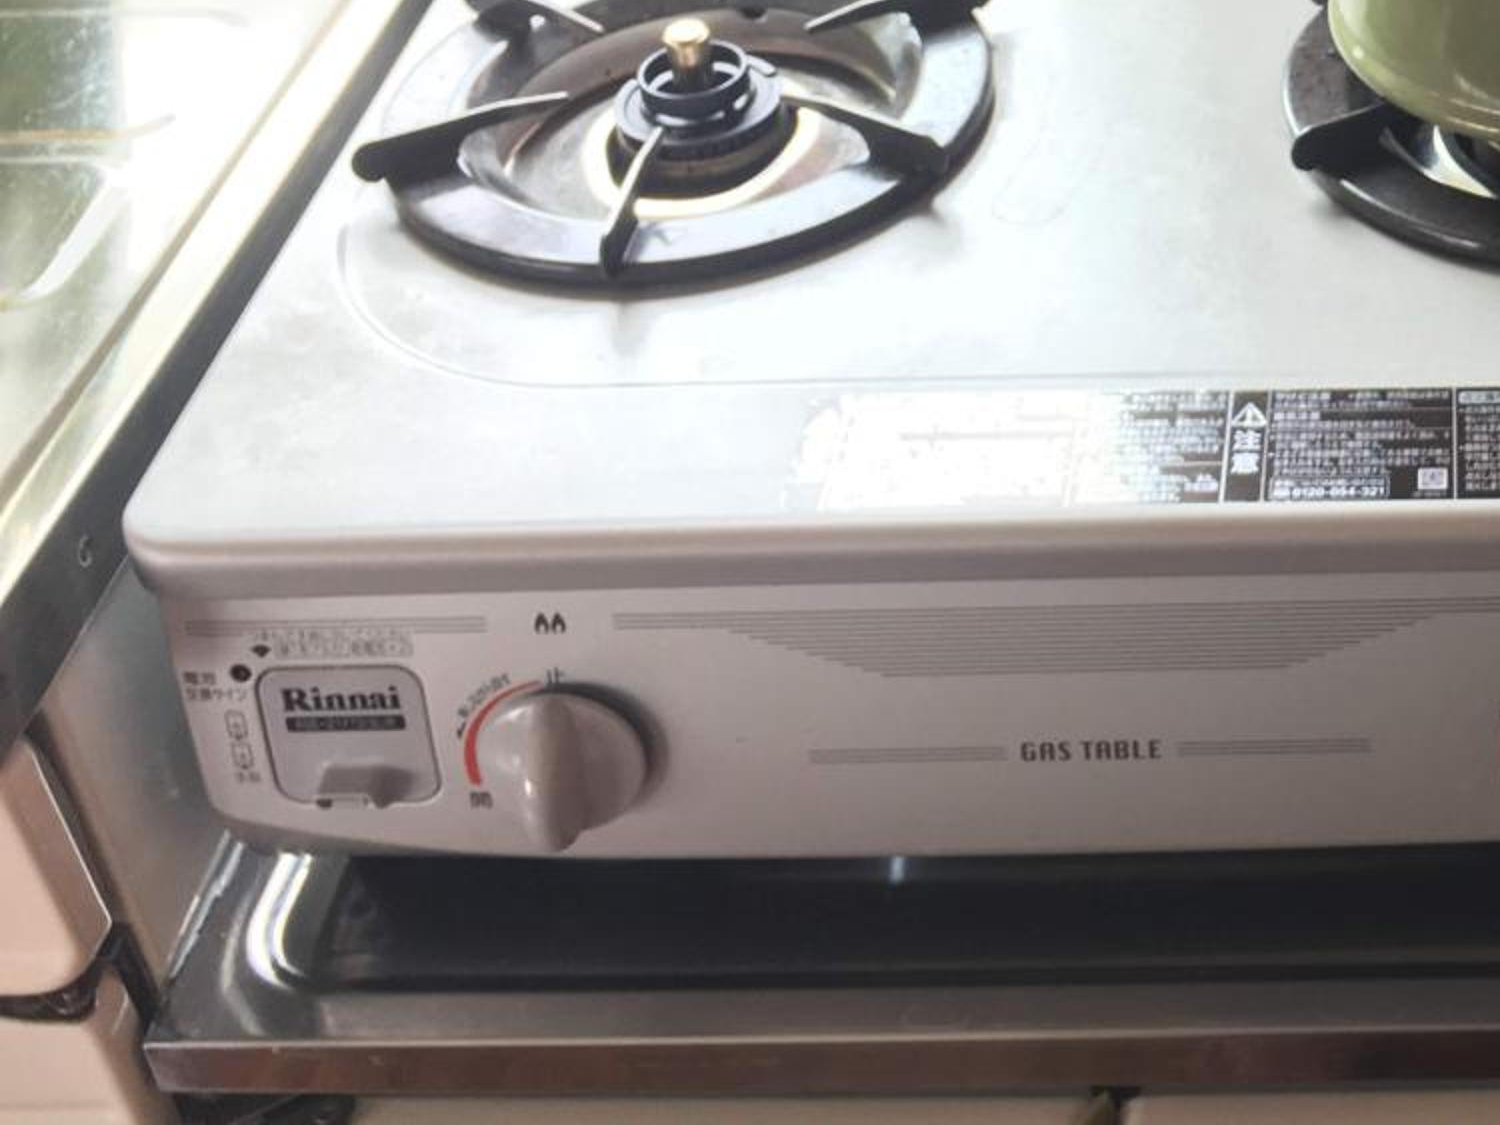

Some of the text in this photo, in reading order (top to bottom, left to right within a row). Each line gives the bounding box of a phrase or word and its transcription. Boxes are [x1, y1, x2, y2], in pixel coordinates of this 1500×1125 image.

[281, 685, 400, 713] Rinnai
[1020, 738, 1163, 762] GAS TABLE
